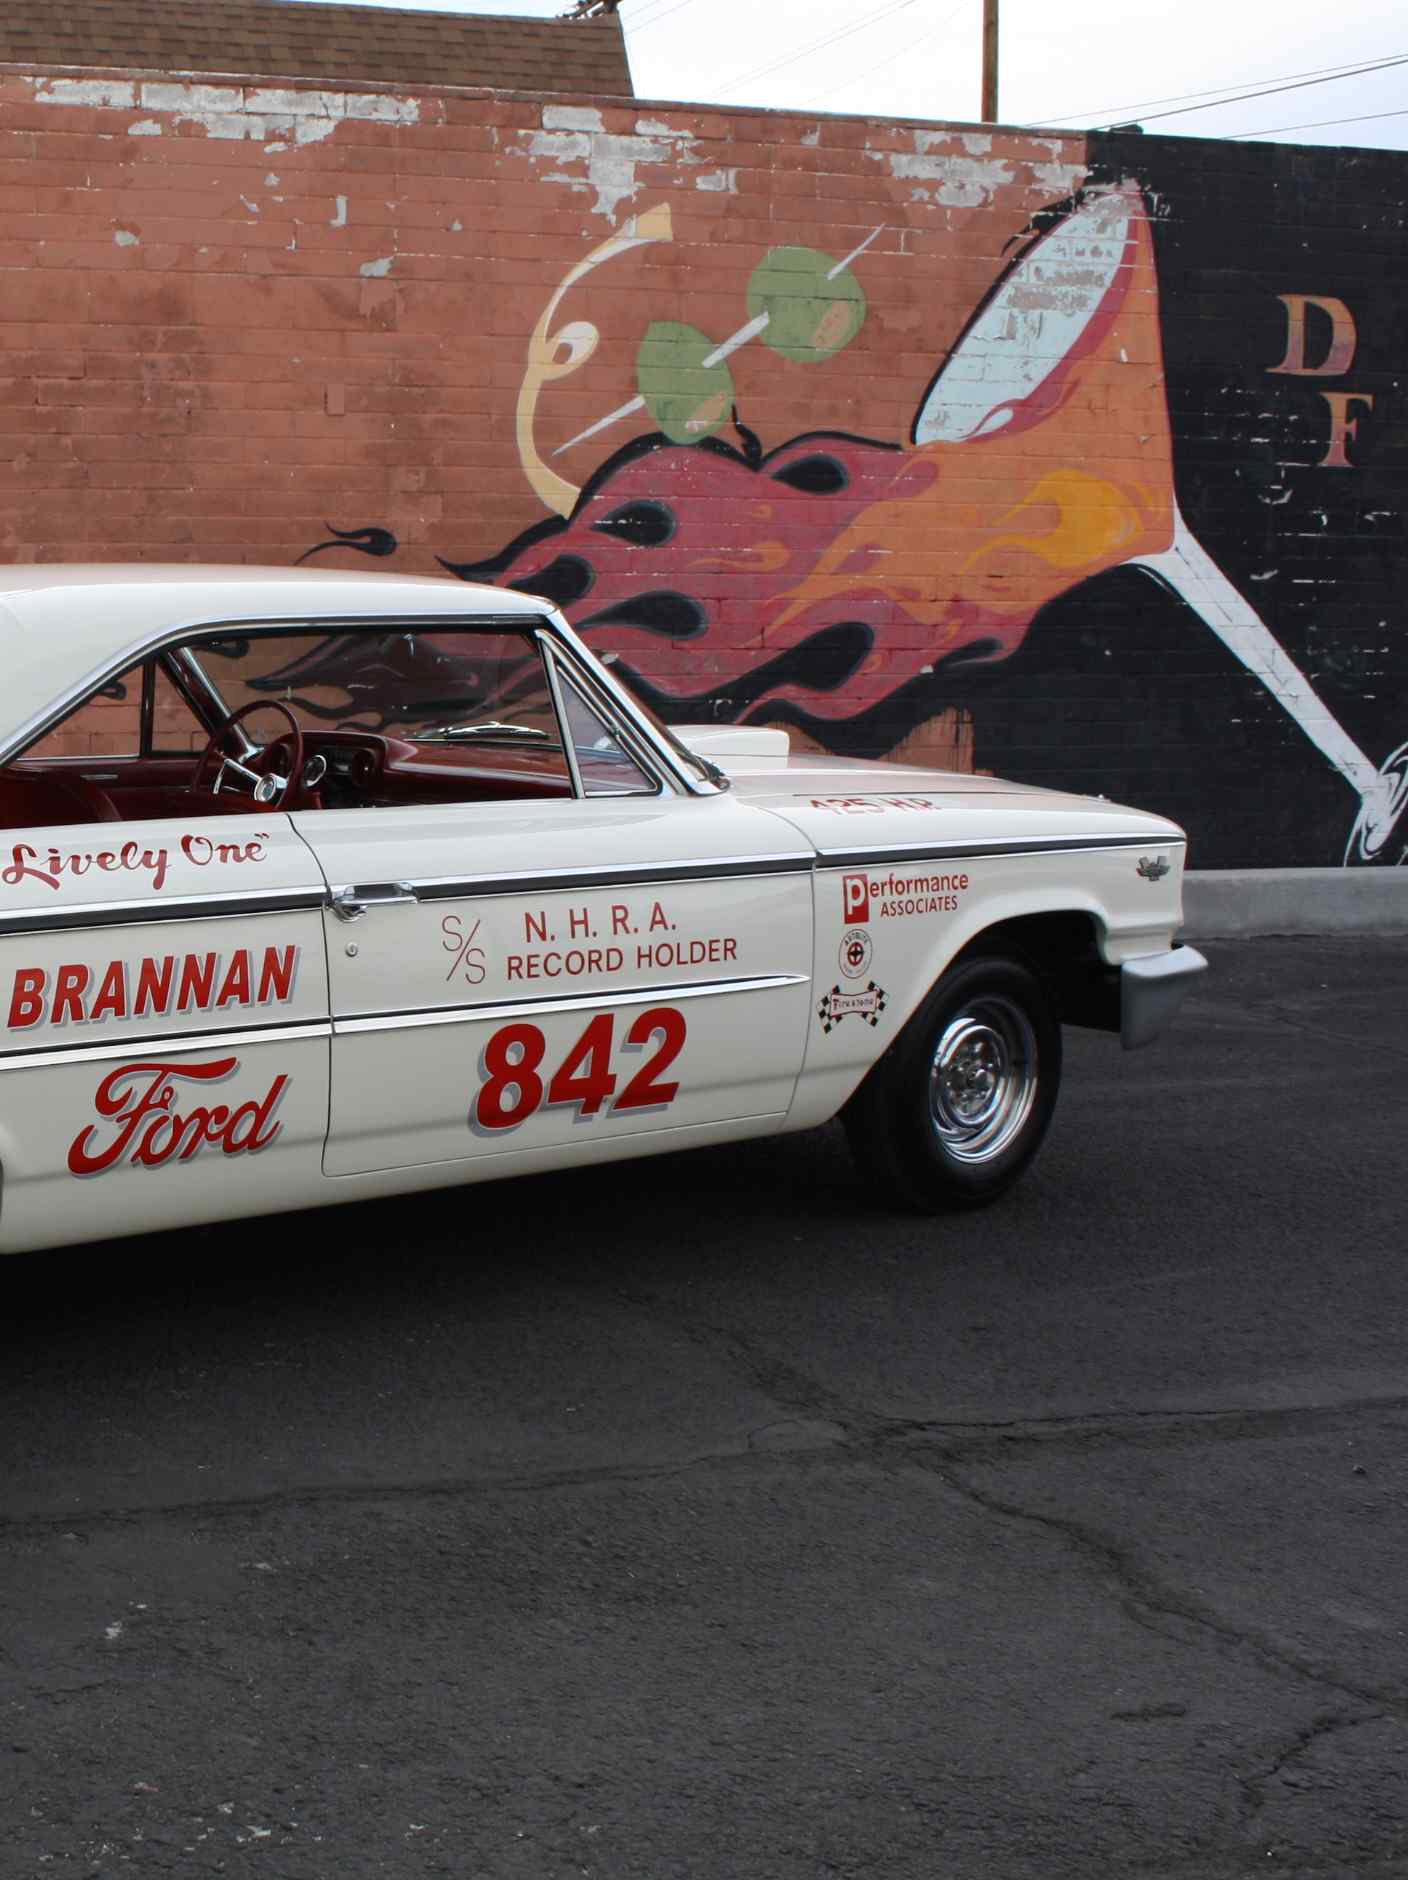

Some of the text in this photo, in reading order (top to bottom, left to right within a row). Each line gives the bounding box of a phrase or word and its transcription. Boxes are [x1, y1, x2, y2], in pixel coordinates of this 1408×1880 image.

[1266, 294, 1358, 377] D
[1316, 391, 1375, 468] F
[879, 894, 959, 918] ASSOCIATES
[7, 943, 298, 1030] BRANNAN
[505, 937, 739, 981] RECORD HOLDER
[476, 1006, 688, 1131] 842
[67, 1055, 289, 1176] Ford
